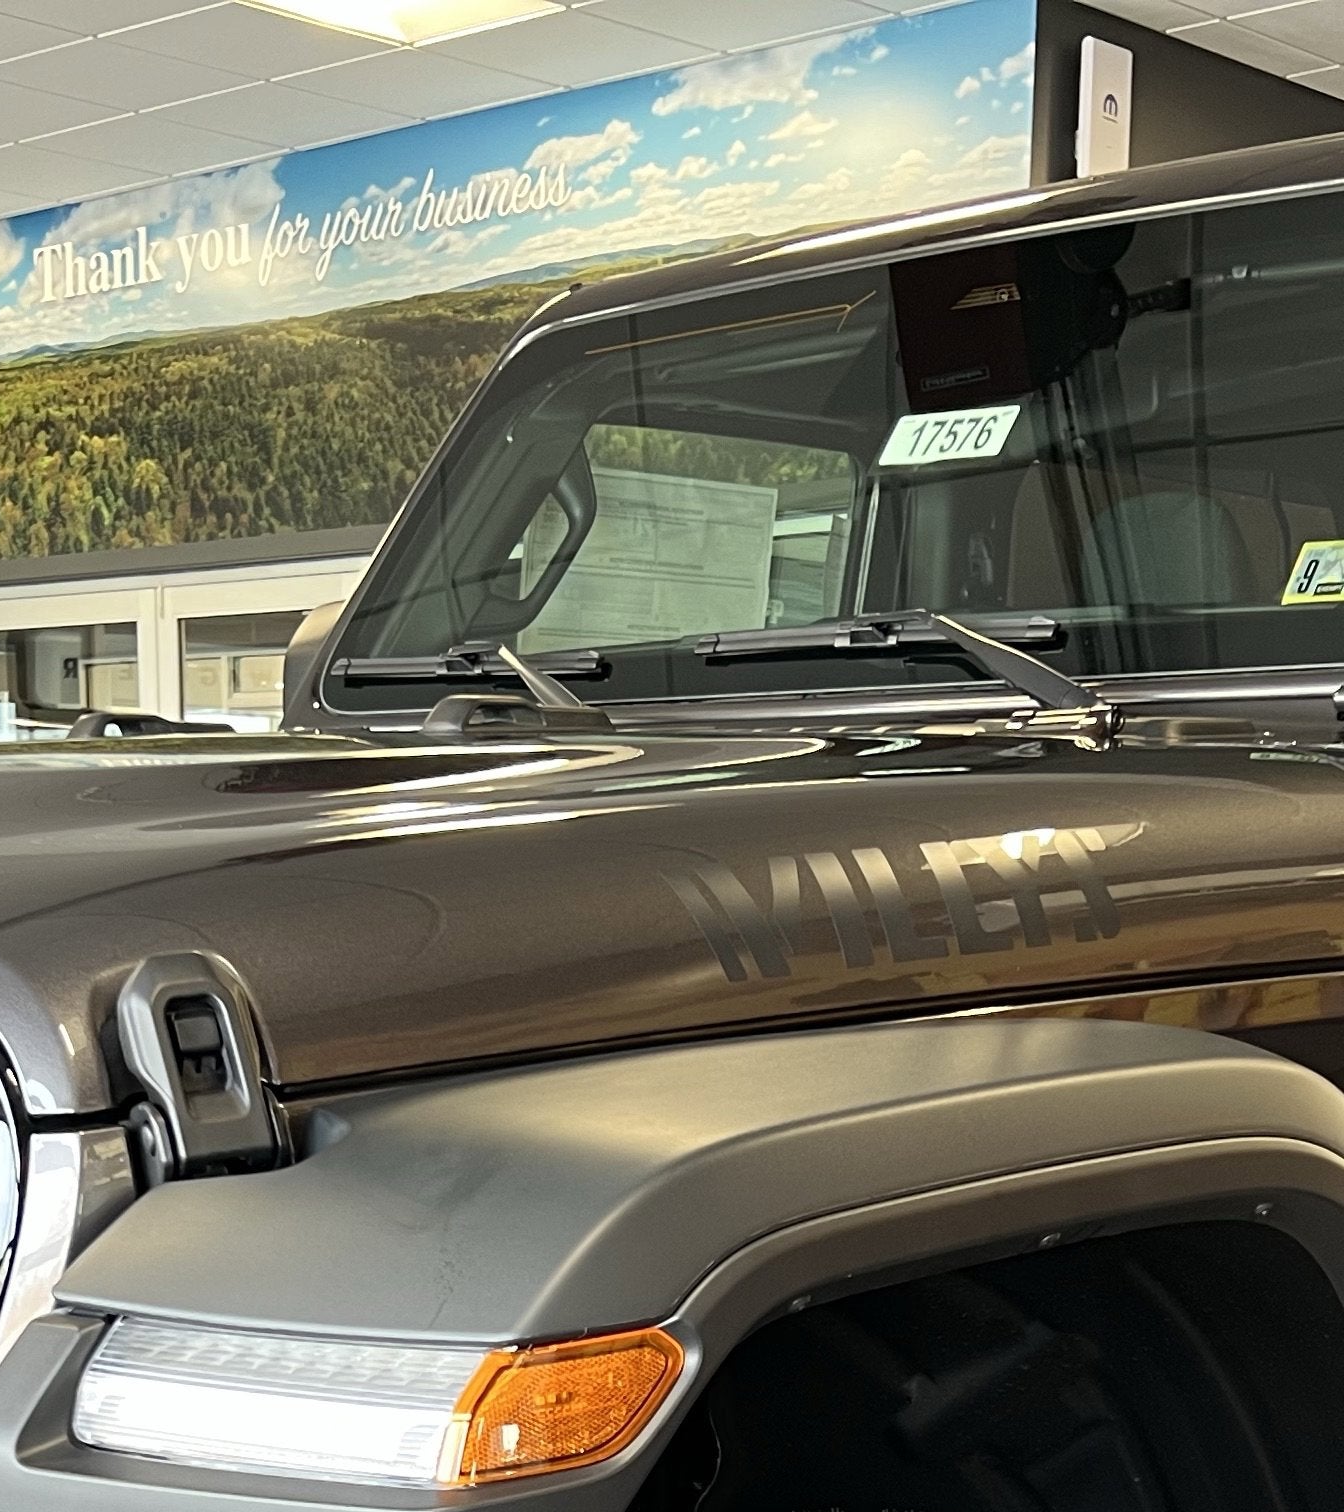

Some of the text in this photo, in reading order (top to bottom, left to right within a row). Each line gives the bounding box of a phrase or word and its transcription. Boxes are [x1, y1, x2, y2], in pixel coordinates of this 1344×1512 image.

[33, 163, 571, 303] Thank you for your business
[908, 414, 998, 457] 17576
[1296, 559, 1320, 594] 9
